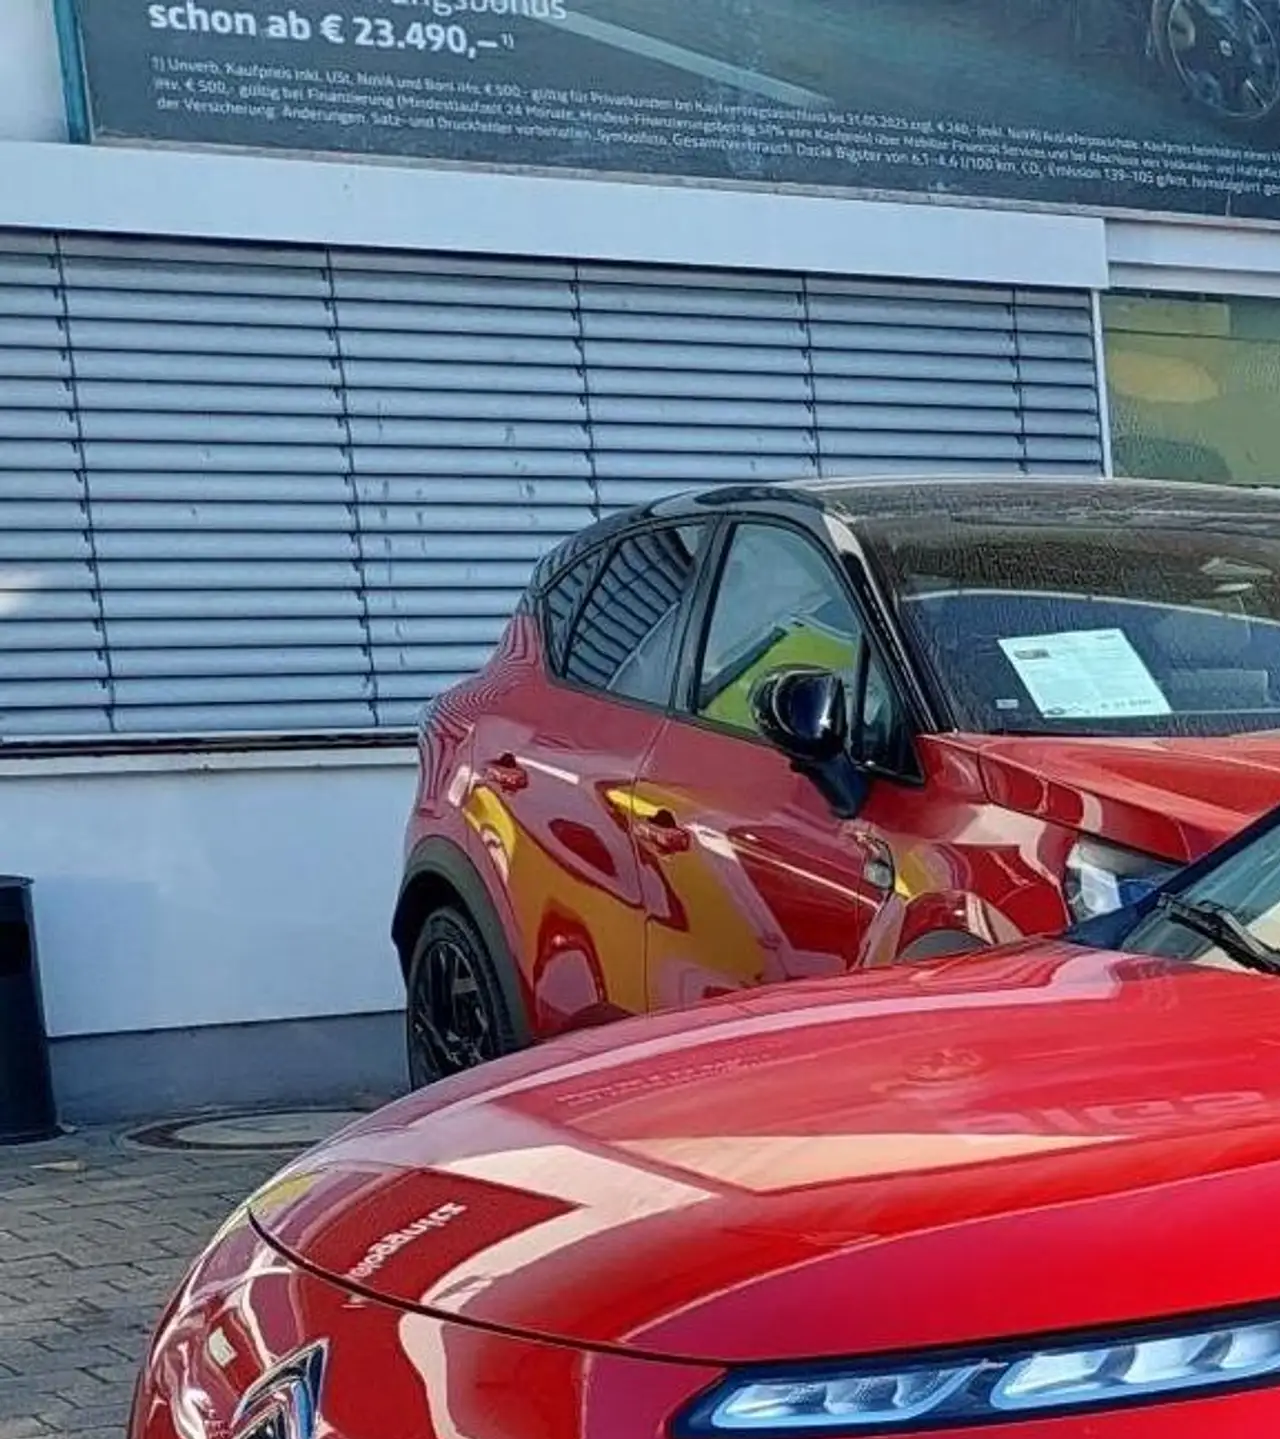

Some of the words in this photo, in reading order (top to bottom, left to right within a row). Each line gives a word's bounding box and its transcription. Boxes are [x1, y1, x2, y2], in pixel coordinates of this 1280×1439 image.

[149, 2, 257, 37] schon
[267, 11, 312, 41] ab
[320, 15, 345, 44] €
[389, 0, 567, 20] gsbonus
[308, 88, 394, 109] Finanzierung
[157, 98, 179, 111] der
[409, 116, 434, 129] und
[797, 143, 832, 158] Dacia
[836, 146, 881, 165] Bigster
